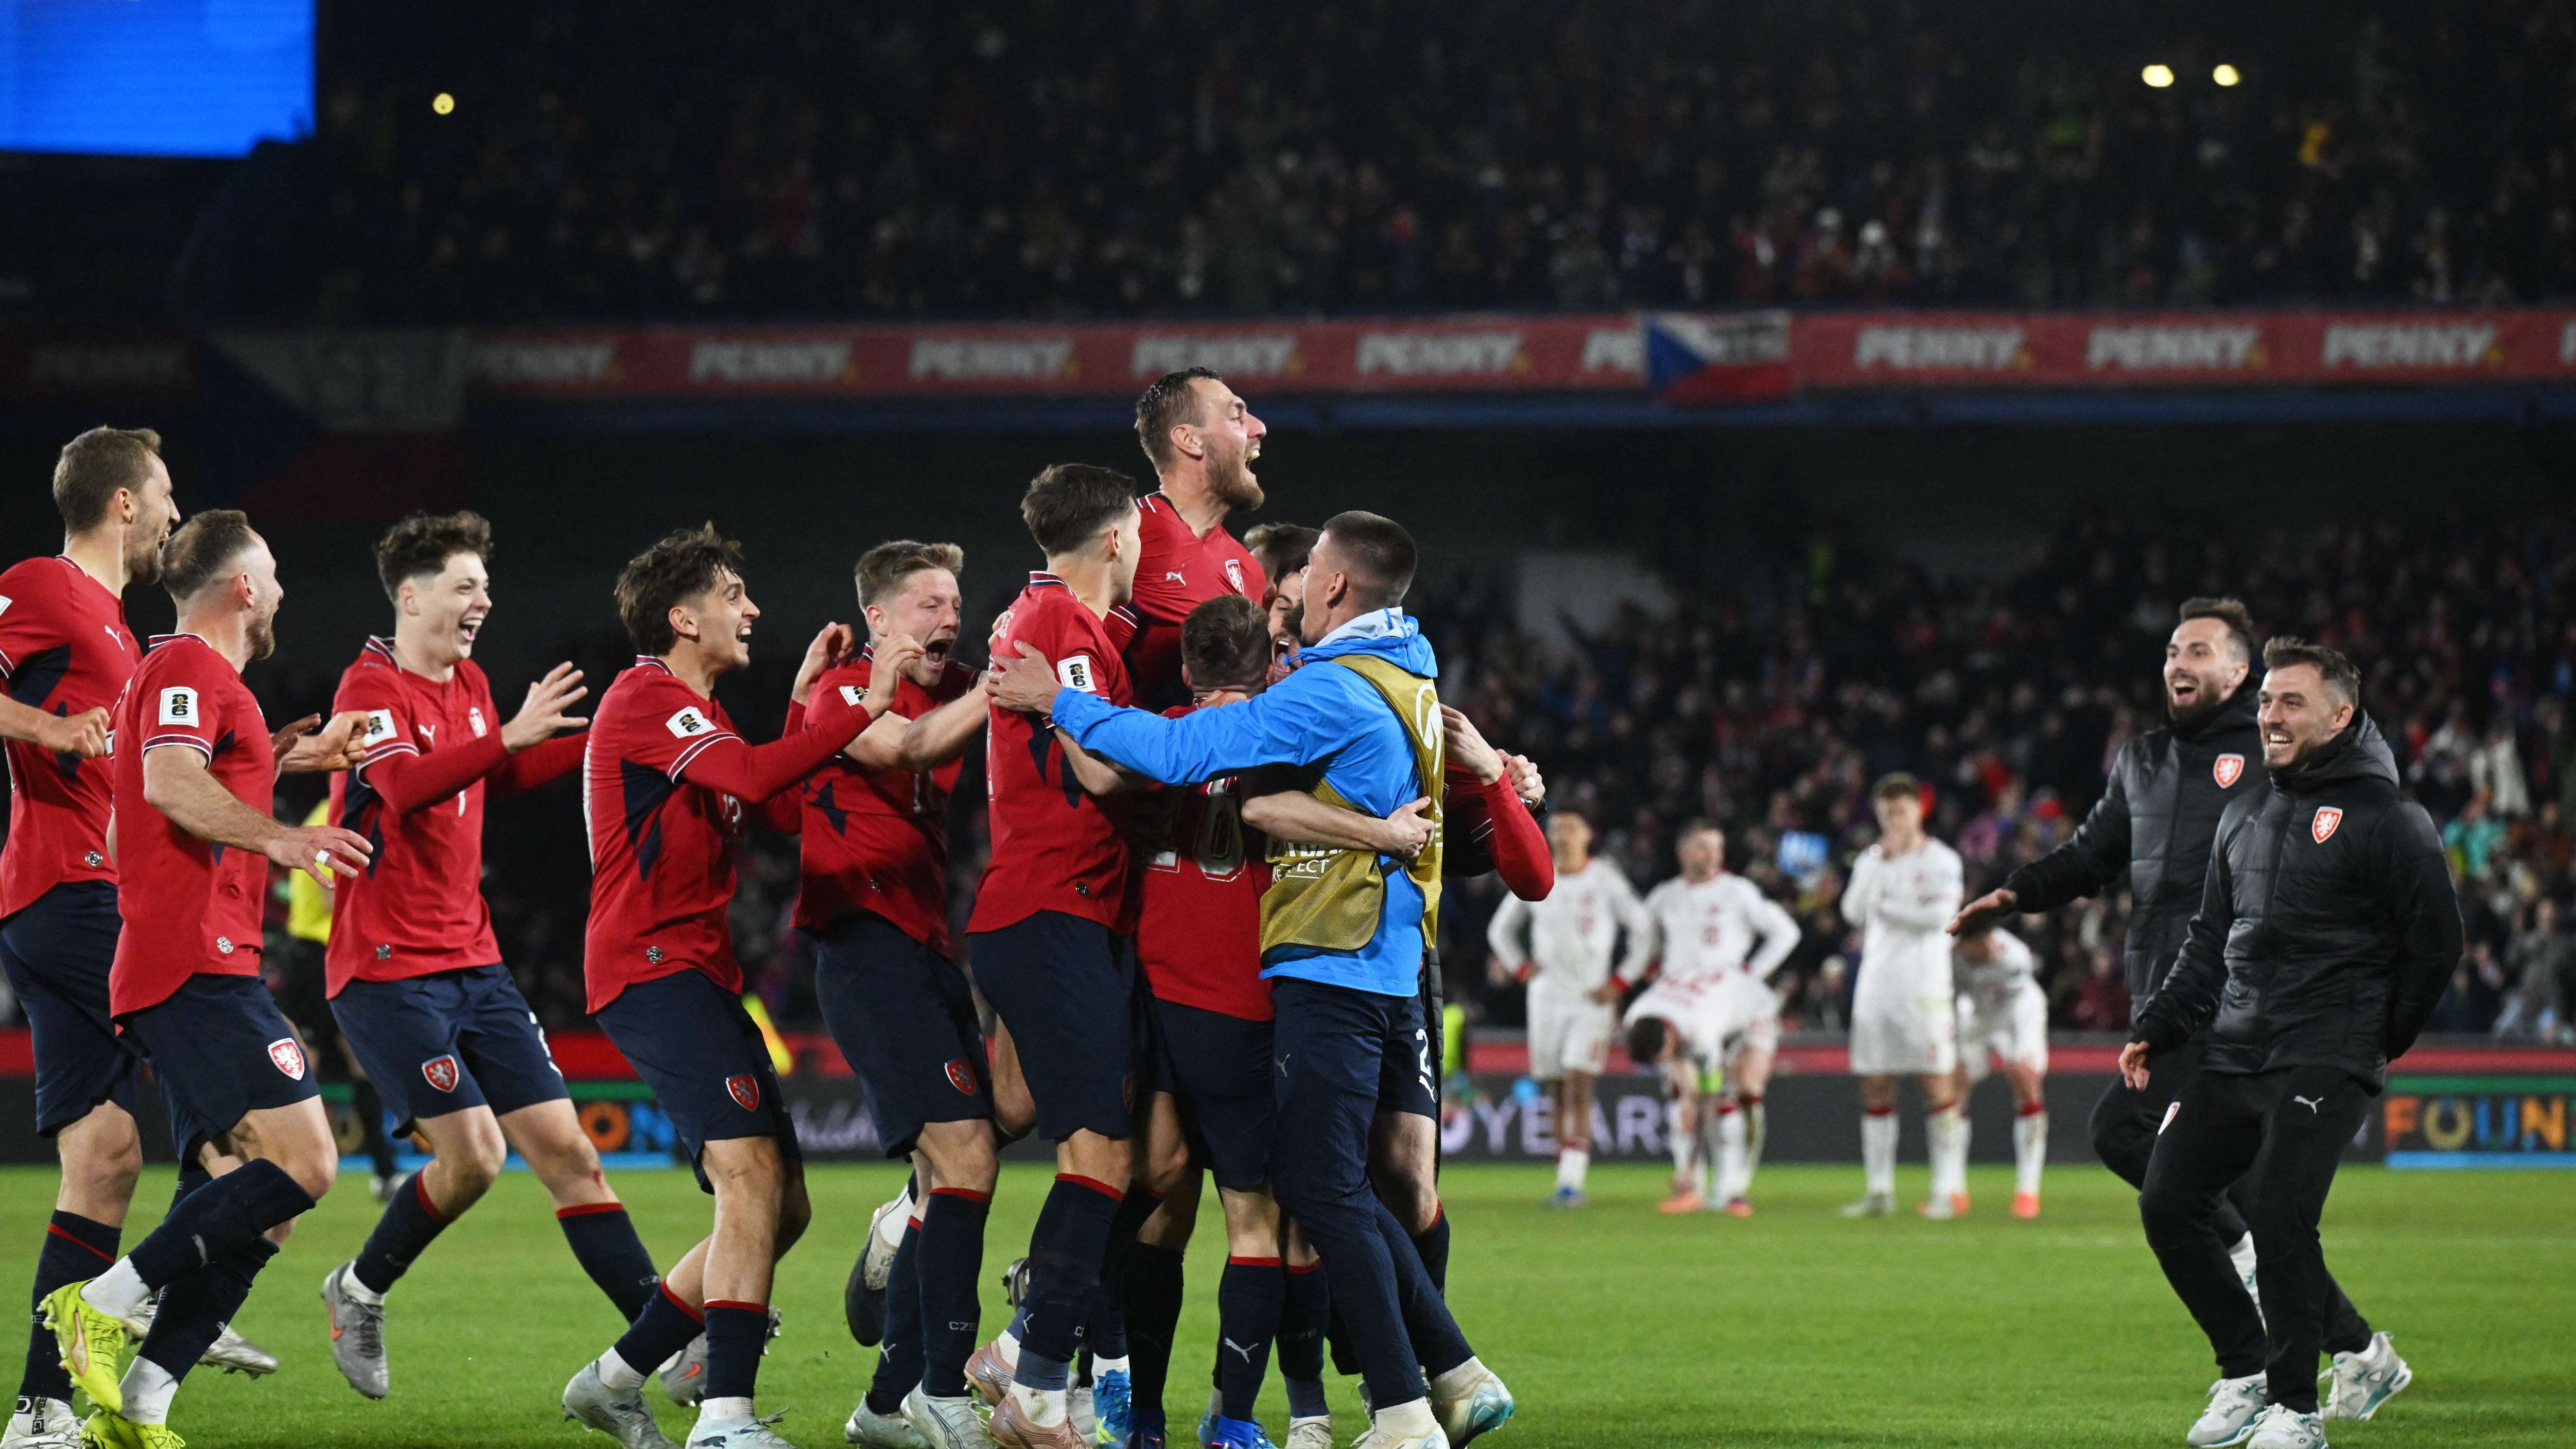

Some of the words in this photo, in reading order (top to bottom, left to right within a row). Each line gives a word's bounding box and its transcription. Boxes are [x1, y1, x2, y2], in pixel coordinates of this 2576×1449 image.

[689, 340, 852, 383] PENNY
[909, 337, 1072, 381] PENNY
[1355, 330, 1524, 376] PENNY
[1855, 325, 2025, 370] PENNY
[2086, 325, 2260, 369] PENNY
[2322, 323, 2497, 369] PENNY
[2382, 1094, 2576, 1153] FOUN
[949, 1321, 977, 1331] CZE
